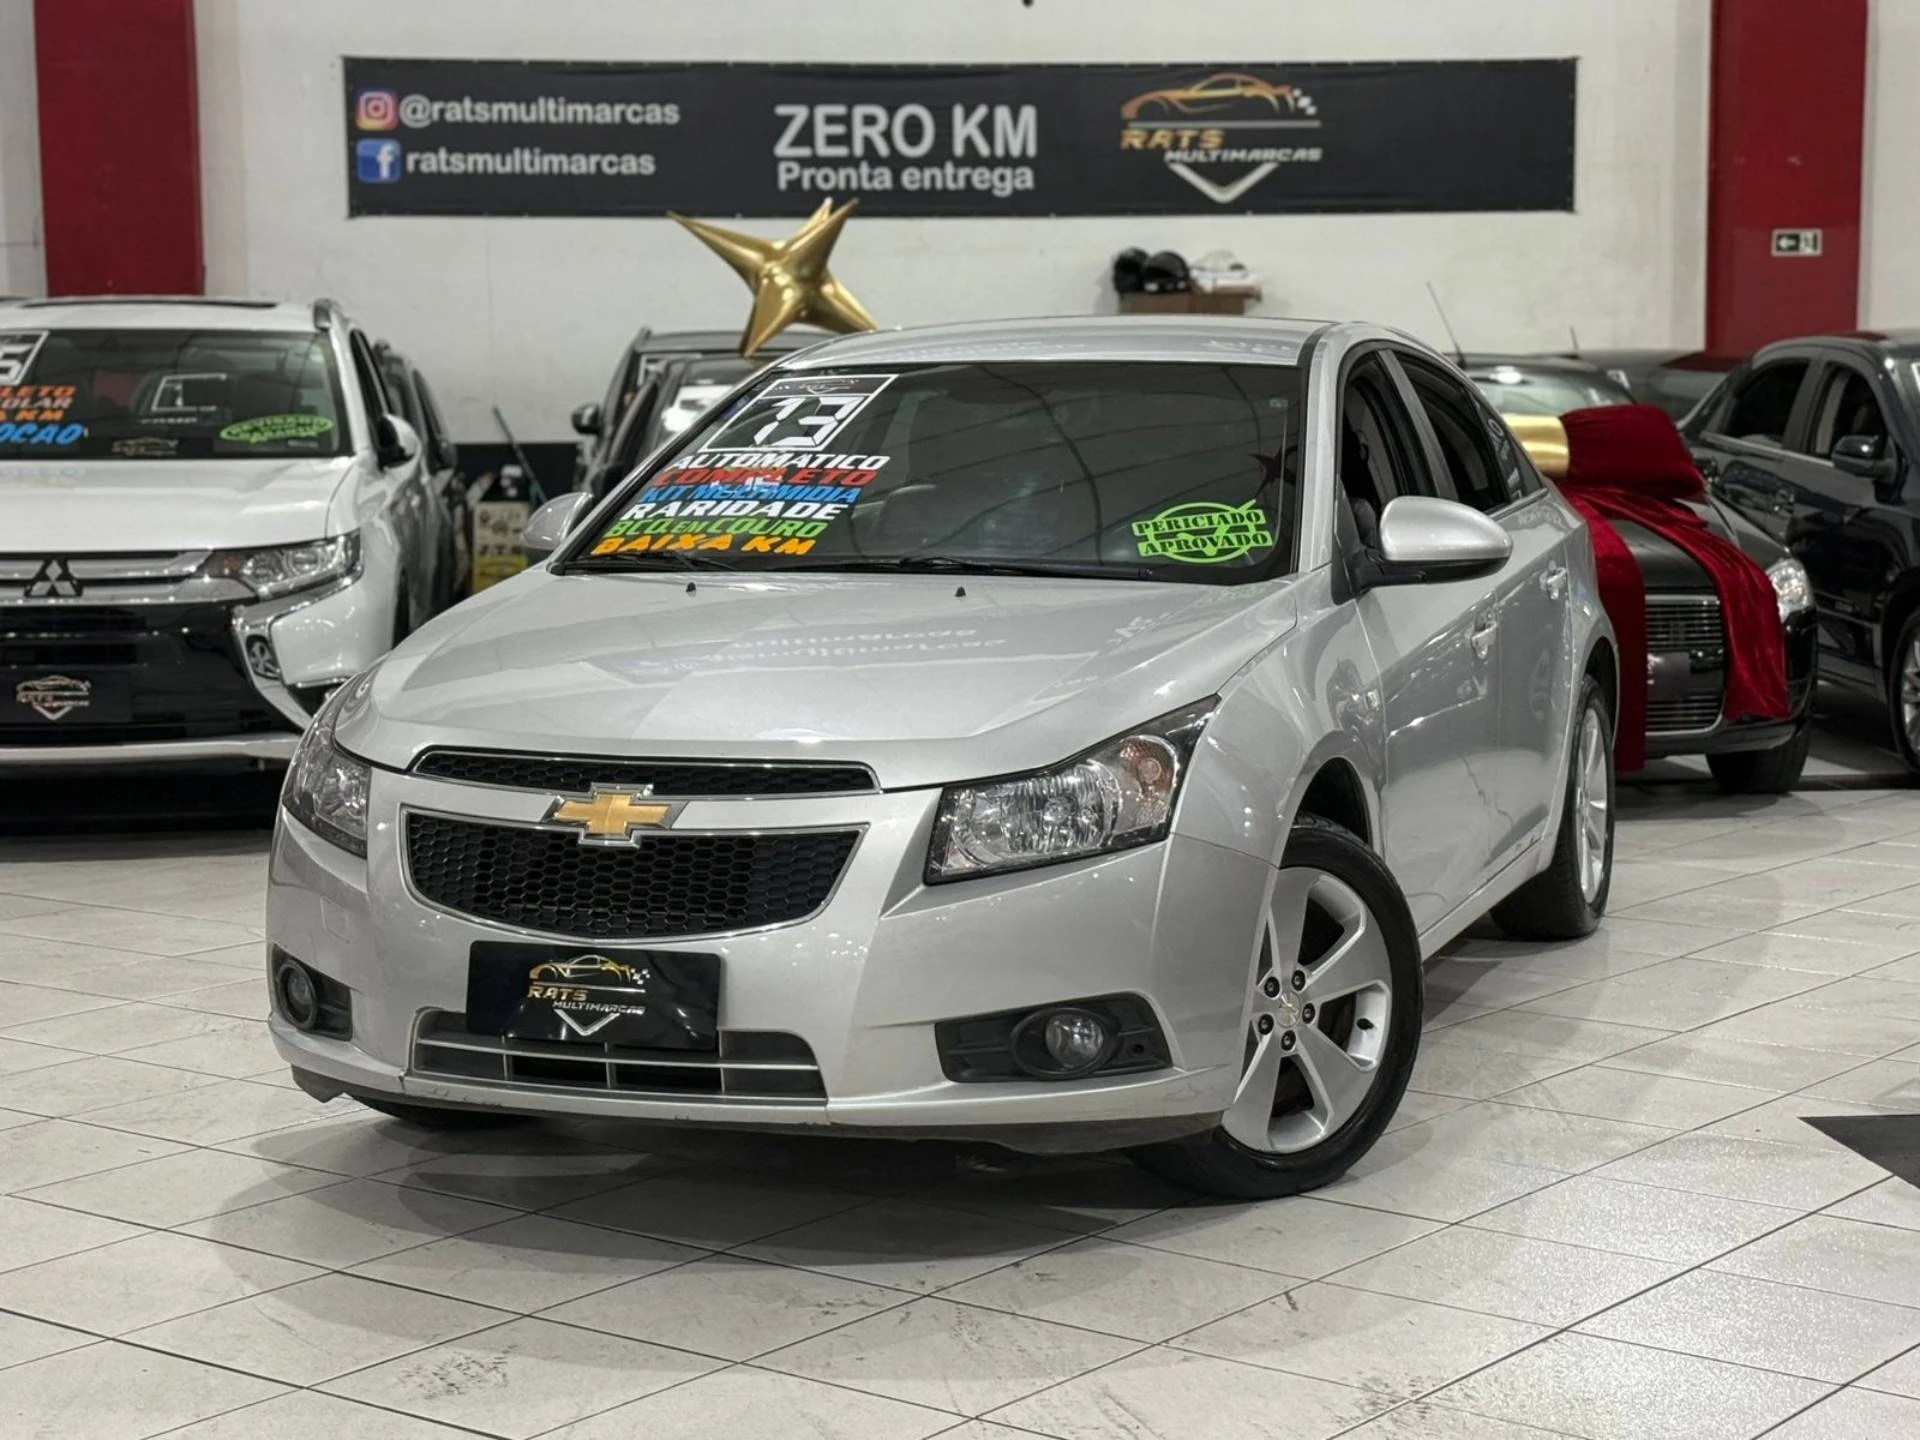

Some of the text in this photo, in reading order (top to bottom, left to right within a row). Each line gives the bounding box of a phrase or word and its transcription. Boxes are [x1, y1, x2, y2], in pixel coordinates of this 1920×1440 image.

[400, 95, 680, 129] @ratsmultimarcas
[773, 104, 1037, 158] ZERO KM
[1121, 129, 1225, 150] RATS
[406, 148, 656, 176] ratsmultimarcas
[1163, 147, 1323, 163] MULTIMARCAS
[778, 161, 1034, 197] Pronta entrega
[752, 396, 866, 447] 13
[618, 500, 849, 521] RARIDADE
[706, 518, 829, 538] COURO
[1137, 511, 1261, 535] PERICIADO
[590, 533, 817, 556] BAIXA KM
[1144, 532, 1269, 555] APROVADO
[527, 985, 589, 1002] RATS
[552, 1000, 646, 1016] MULTIMARCAS
